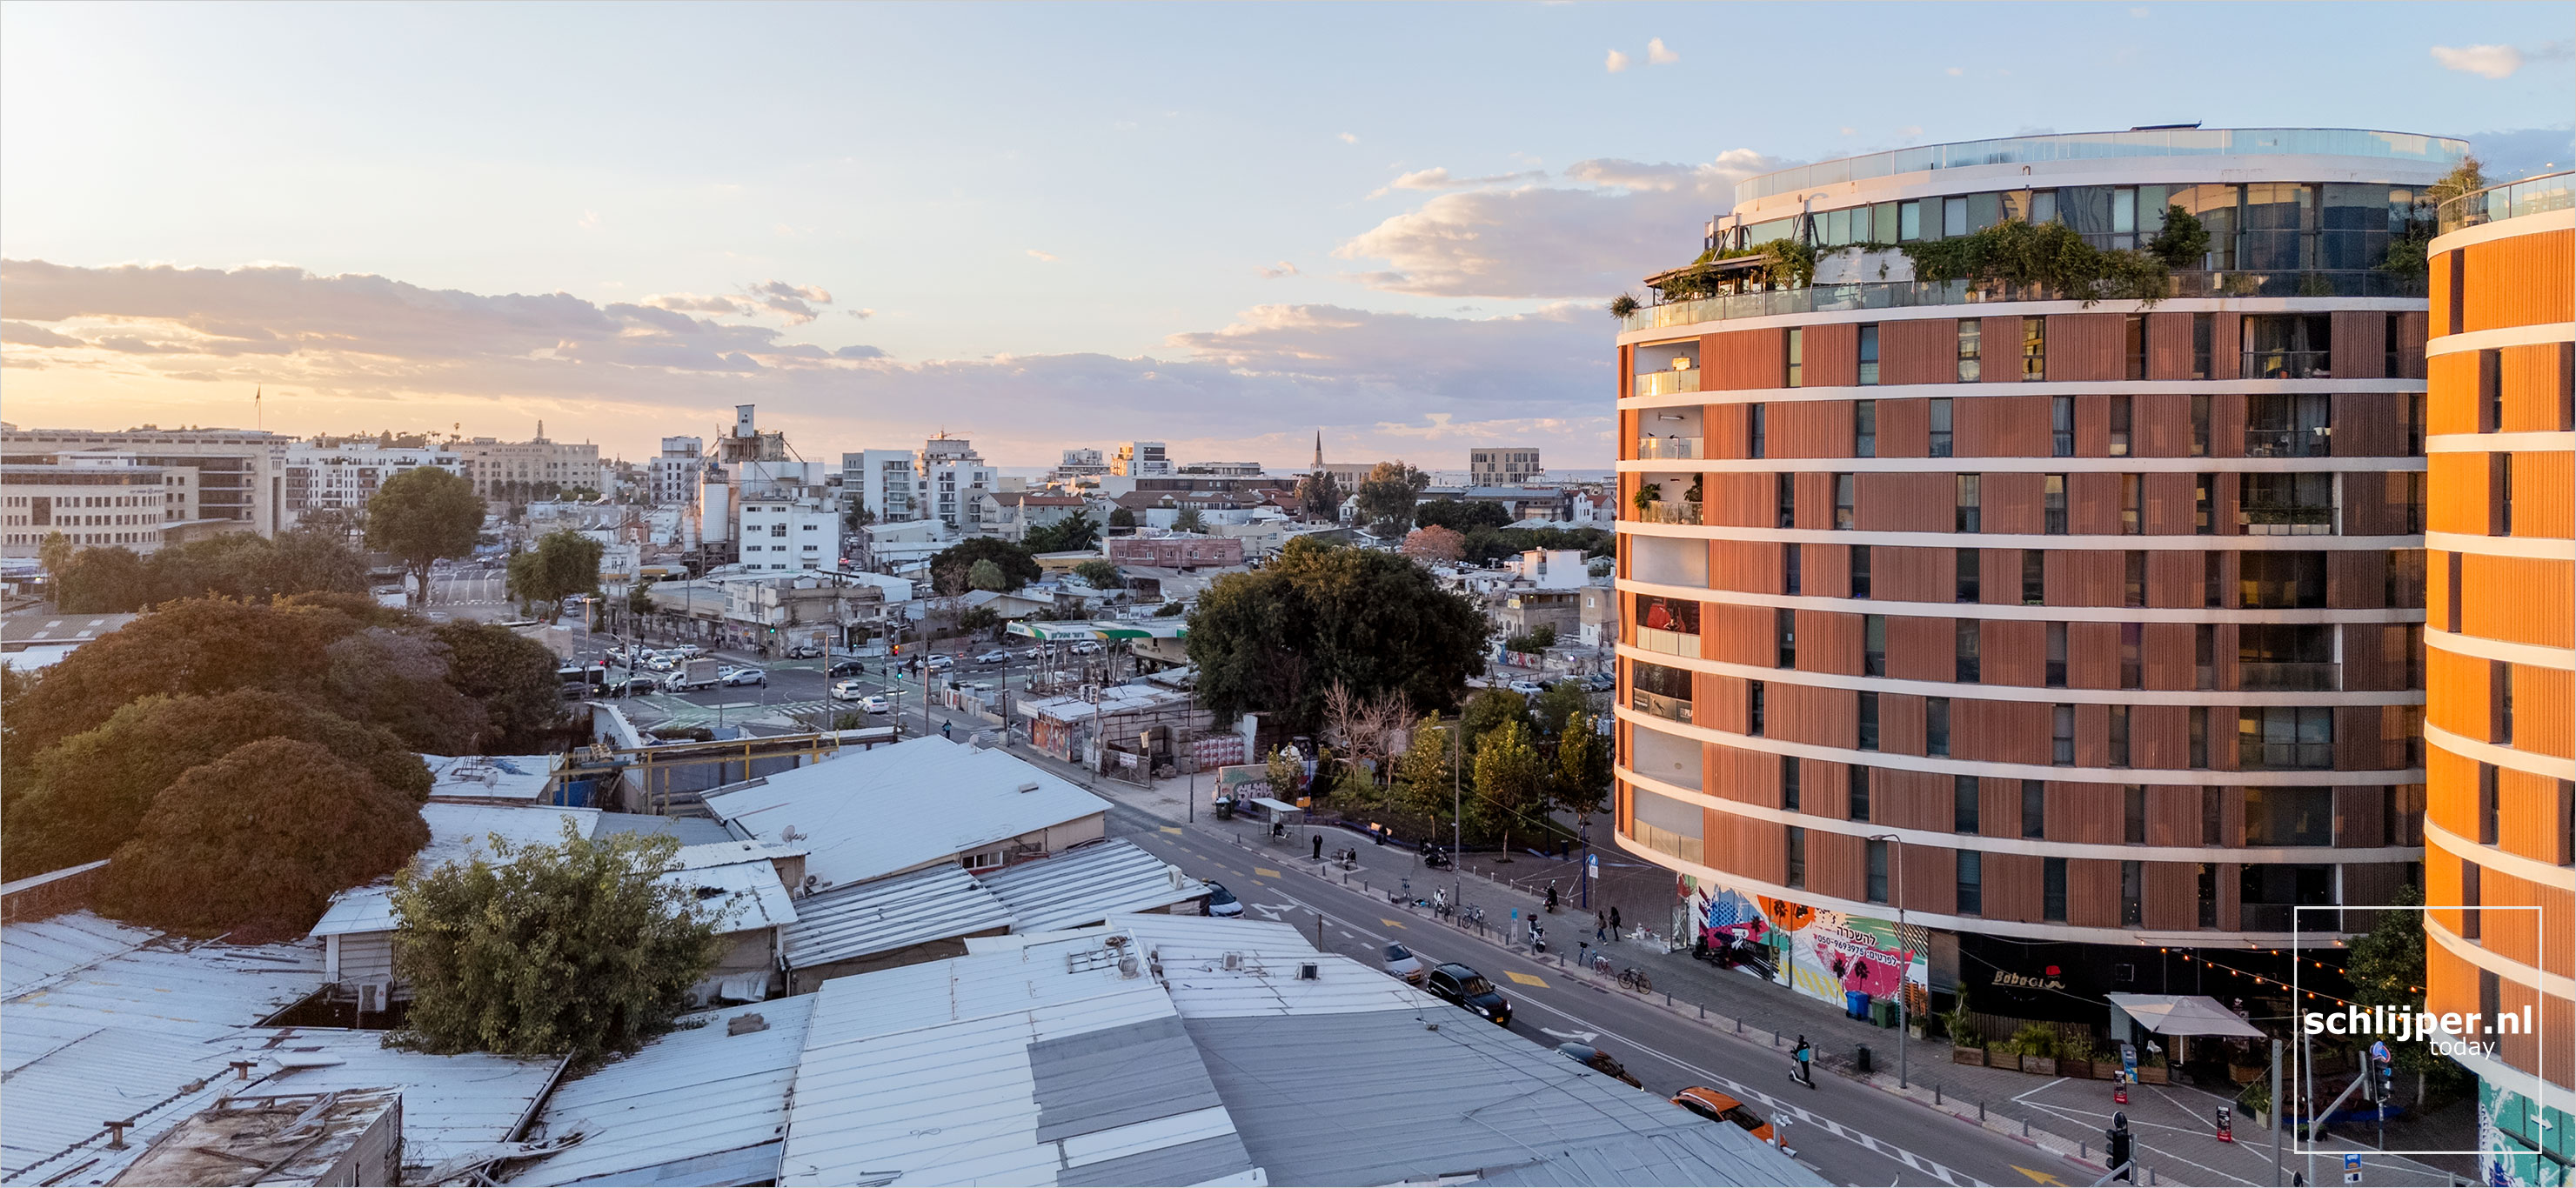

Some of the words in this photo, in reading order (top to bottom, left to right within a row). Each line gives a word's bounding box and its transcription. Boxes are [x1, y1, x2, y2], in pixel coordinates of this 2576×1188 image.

[1817, 934, 1864, 956] 050-9693975
[1837, 925, 1876, 945] להשכרה
[1867, 951, 1897, 965] לפרטים:
